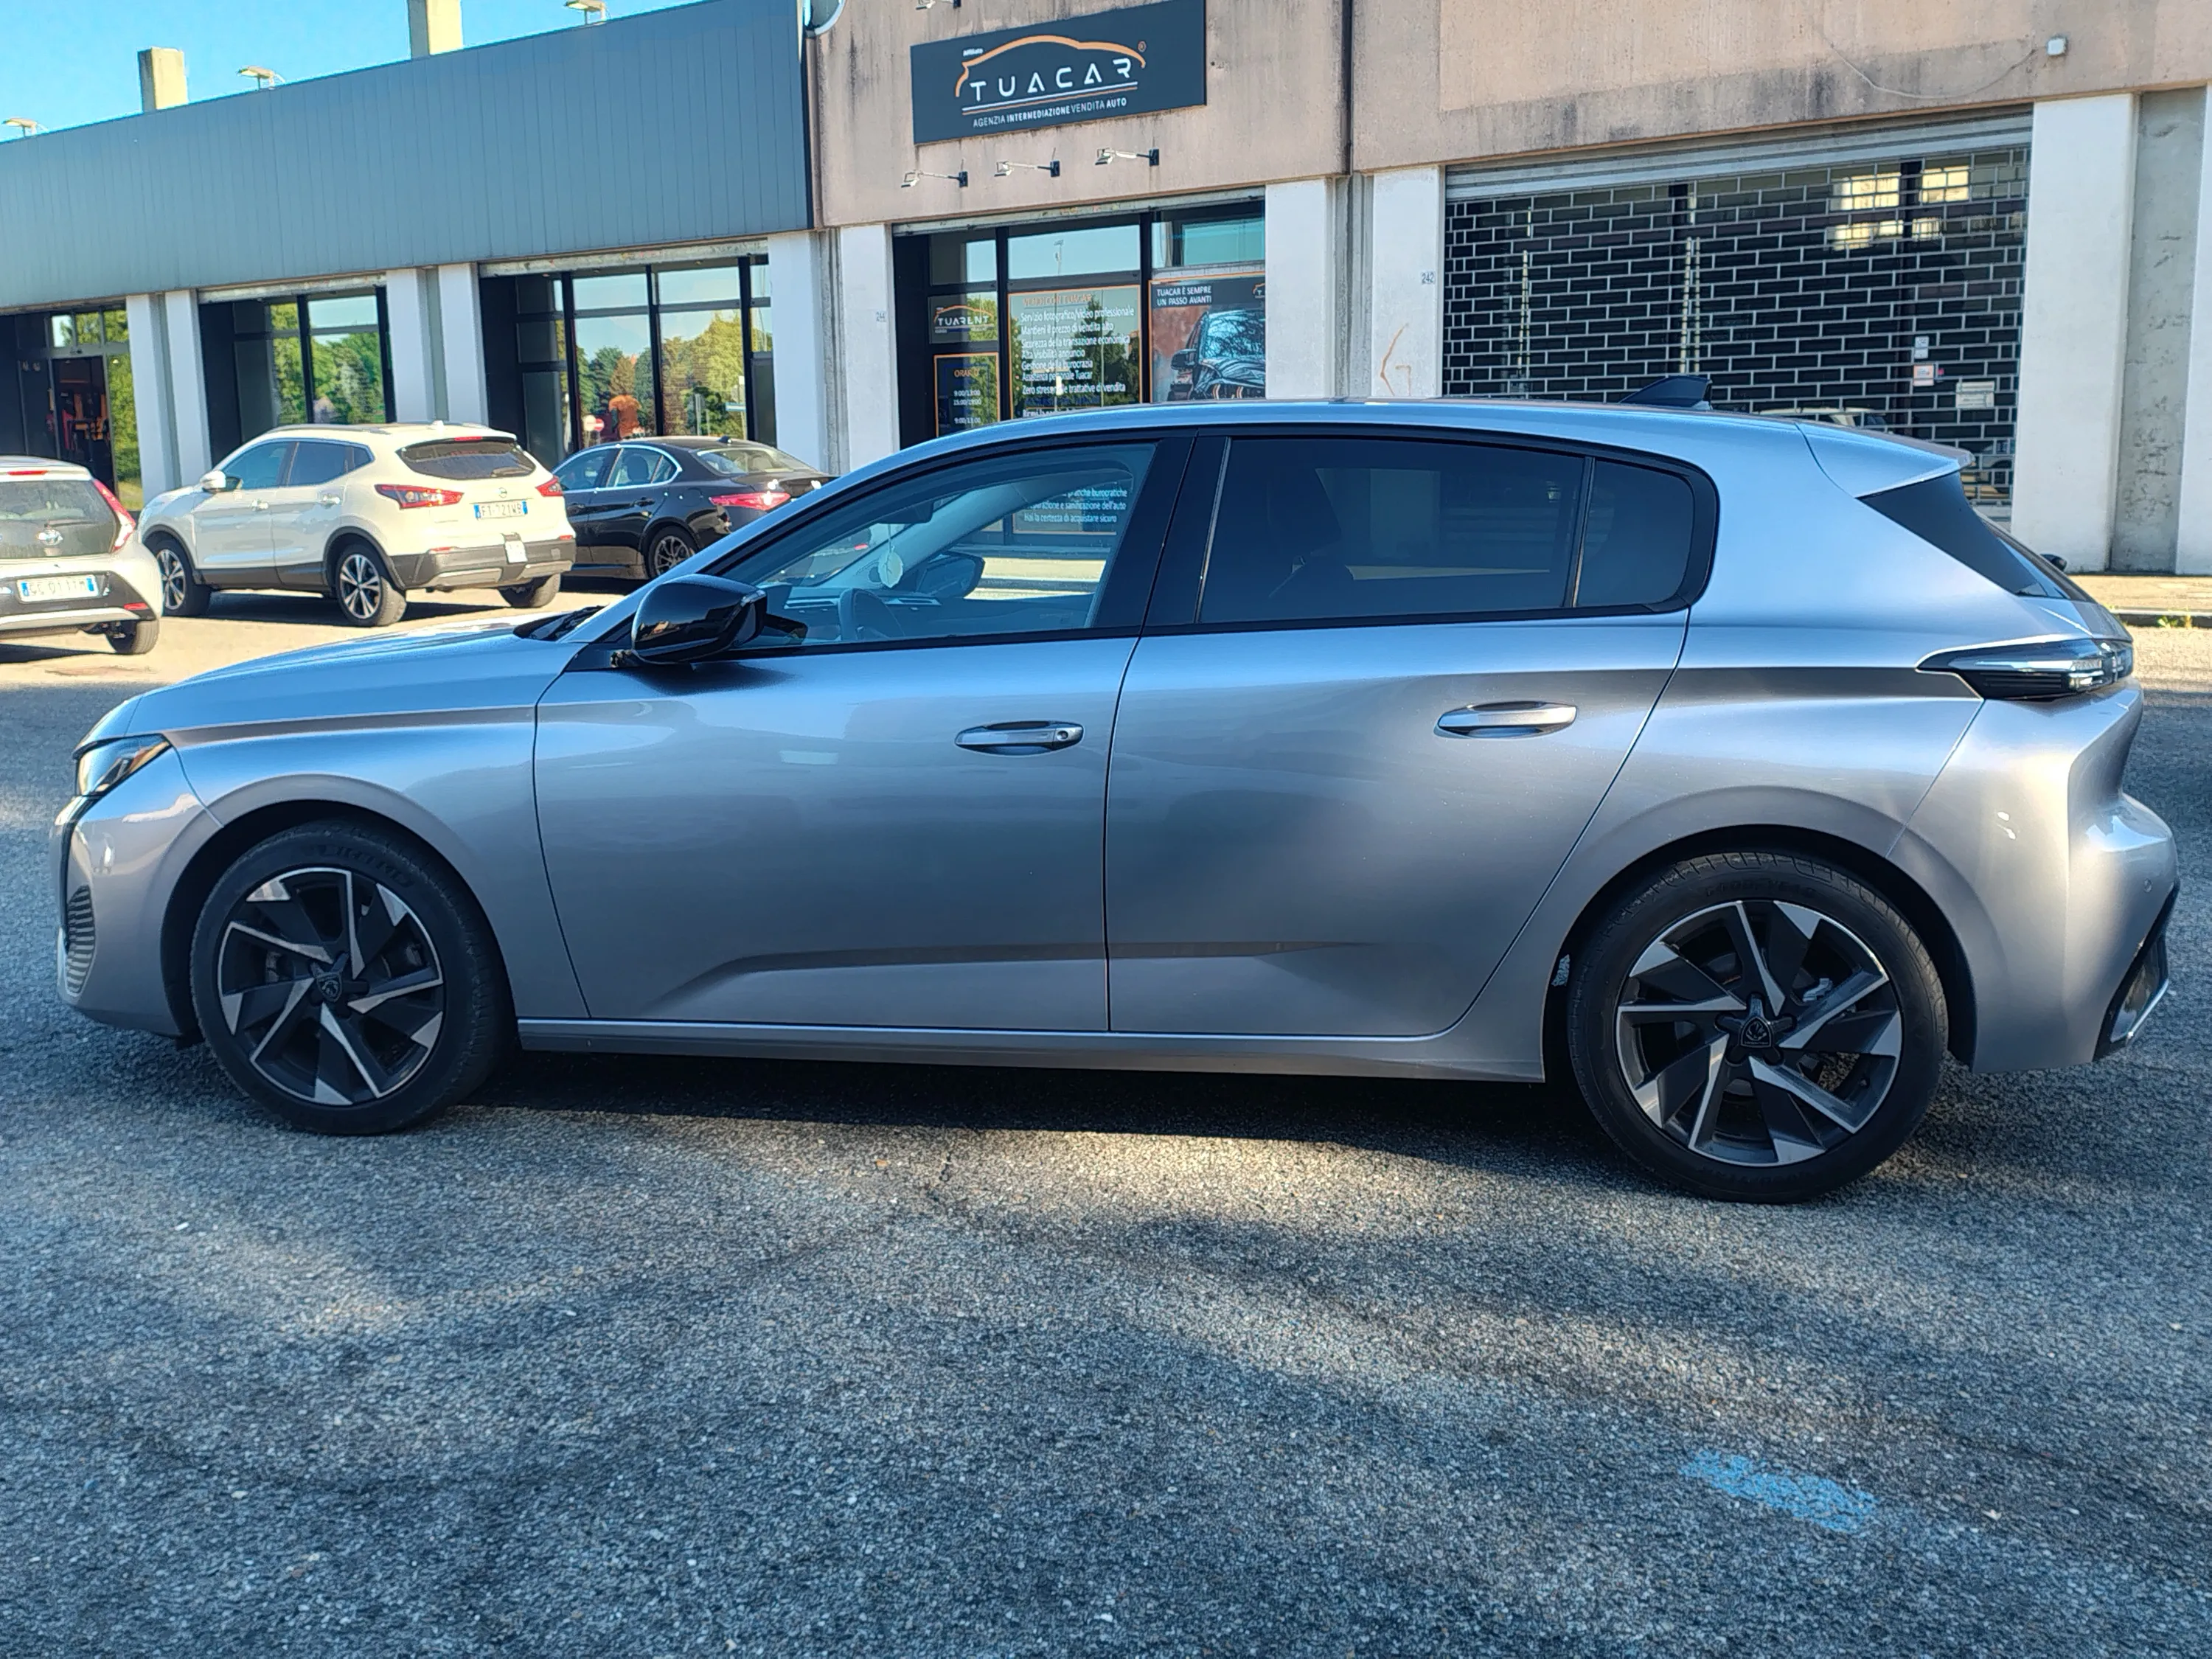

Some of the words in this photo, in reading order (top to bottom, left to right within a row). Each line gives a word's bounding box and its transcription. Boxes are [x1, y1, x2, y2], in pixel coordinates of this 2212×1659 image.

[970, 58, 1132, 102] TUACAR
[973, 115, 1006, 128] AGENZIA
[1006, 105, 1070, 124] INTERMEDIAZIONE
[1071, 100, 1105, 114] VENDITA
[1106, 97, 1127, 109] AUTO
[1156, 288, 1180, 297] TUACAR
[1187, 285, 1212, 295] SEMPRE
[1157, 299, 1167, 307] UN
[1168, 296, 1188, 305] PASSO
[1189, 295, 1212, 304] AVANTI
[1094, 305, 1135, 320] professionale
[937, 316, 989, 327] TUARENT
[1022, 385, 1035, 395] Zero
